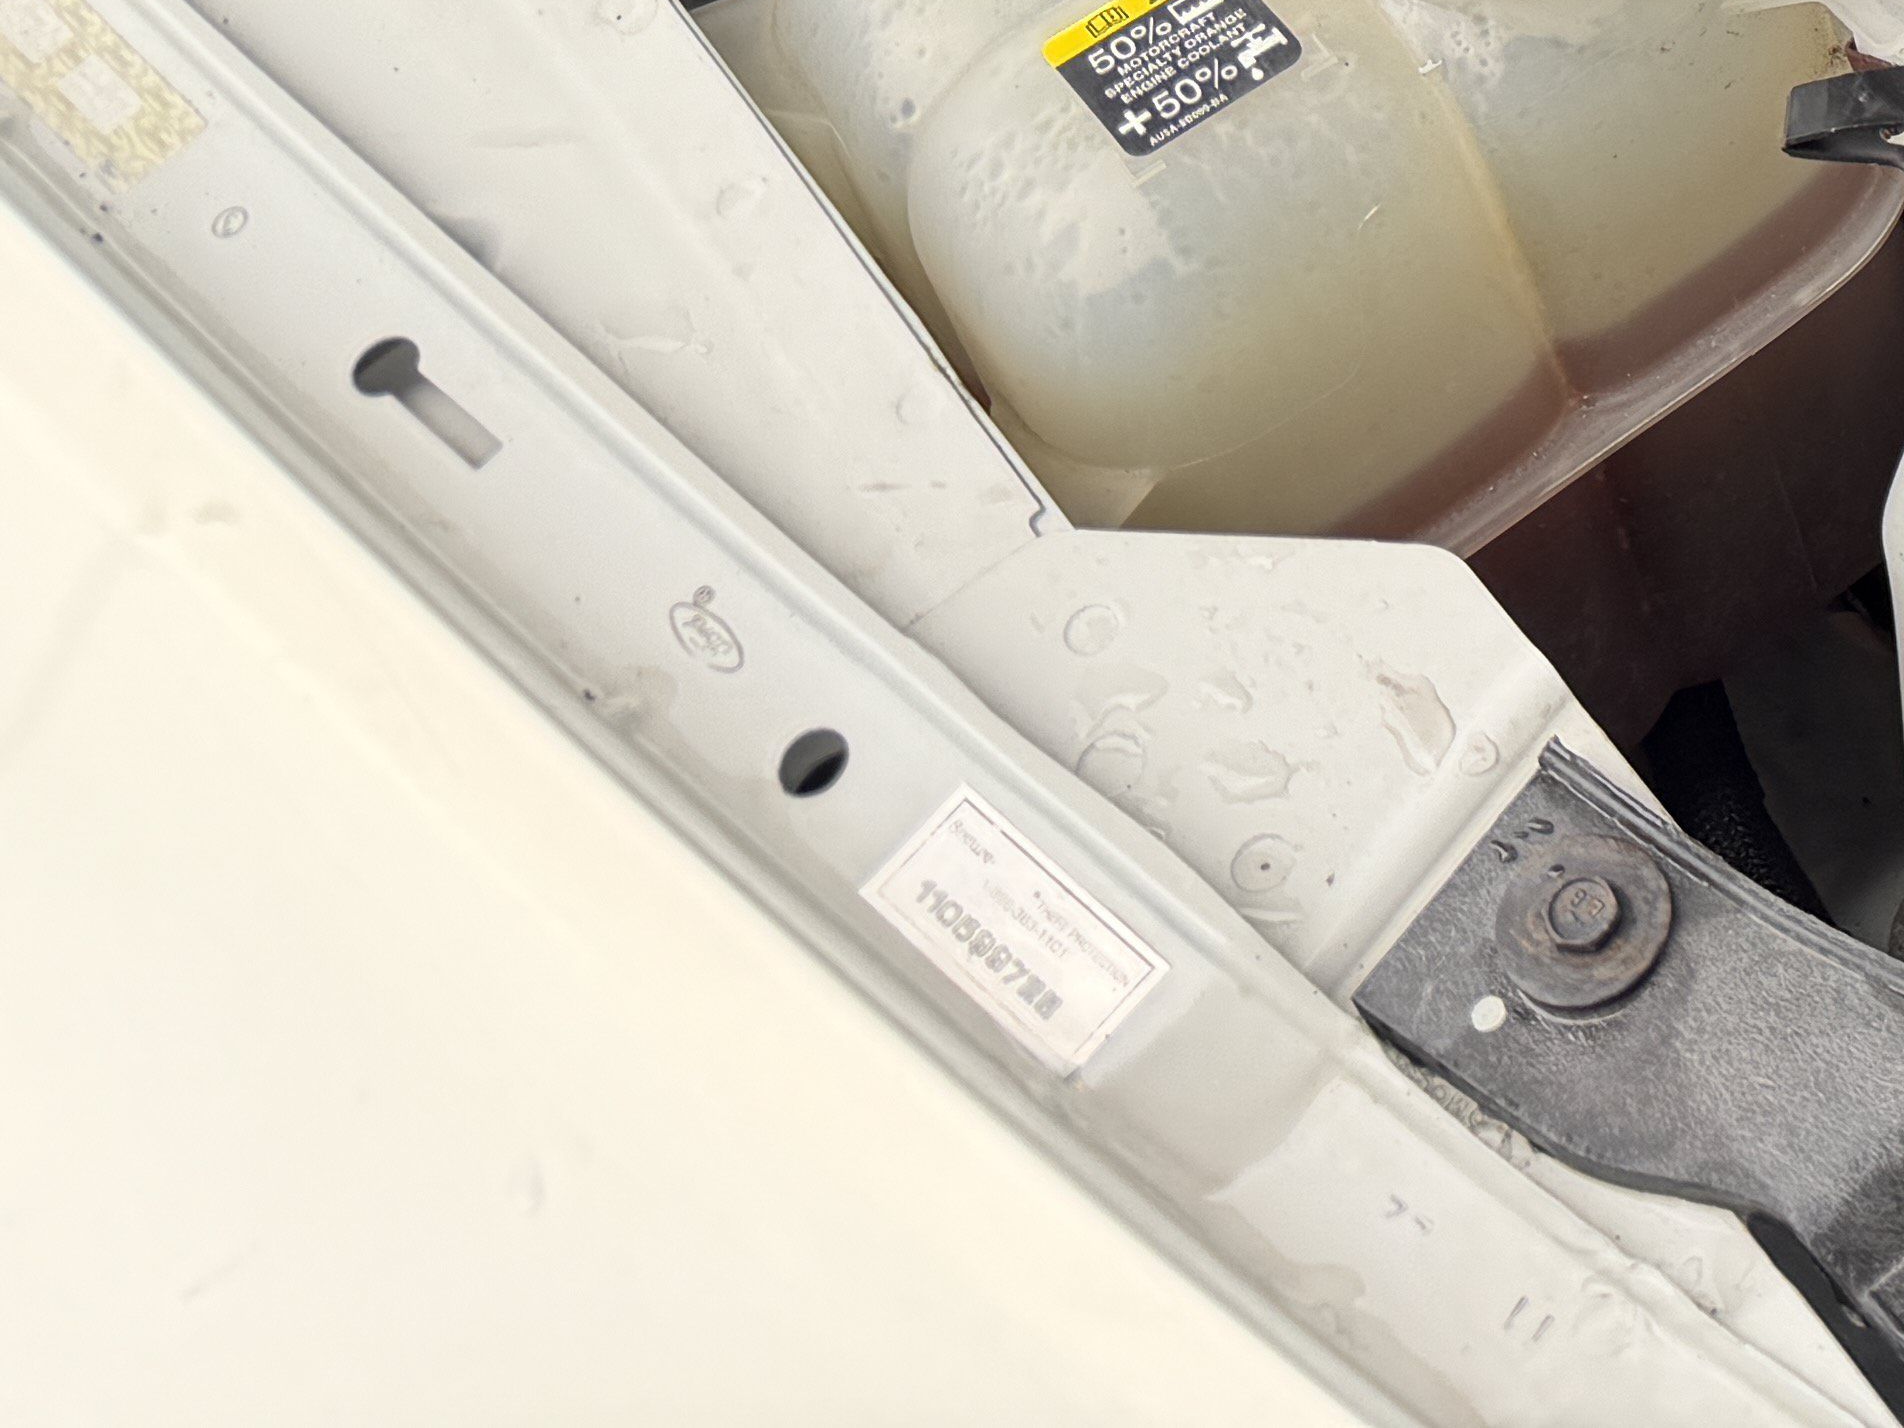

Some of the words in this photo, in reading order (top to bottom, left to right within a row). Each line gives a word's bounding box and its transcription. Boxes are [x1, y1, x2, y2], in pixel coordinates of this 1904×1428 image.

[1087, 16, 1172, 75] 50%
[1104, 42, 1183, 100] SPECIALTY
[1185, 7, 1248, 50] ORANGE
[1116, 11, 1218, 76] MOTORCRAFT
[1120, 65, 1178, 106] ENGINE
[1176, 23, 1248, 69] COOLANT
